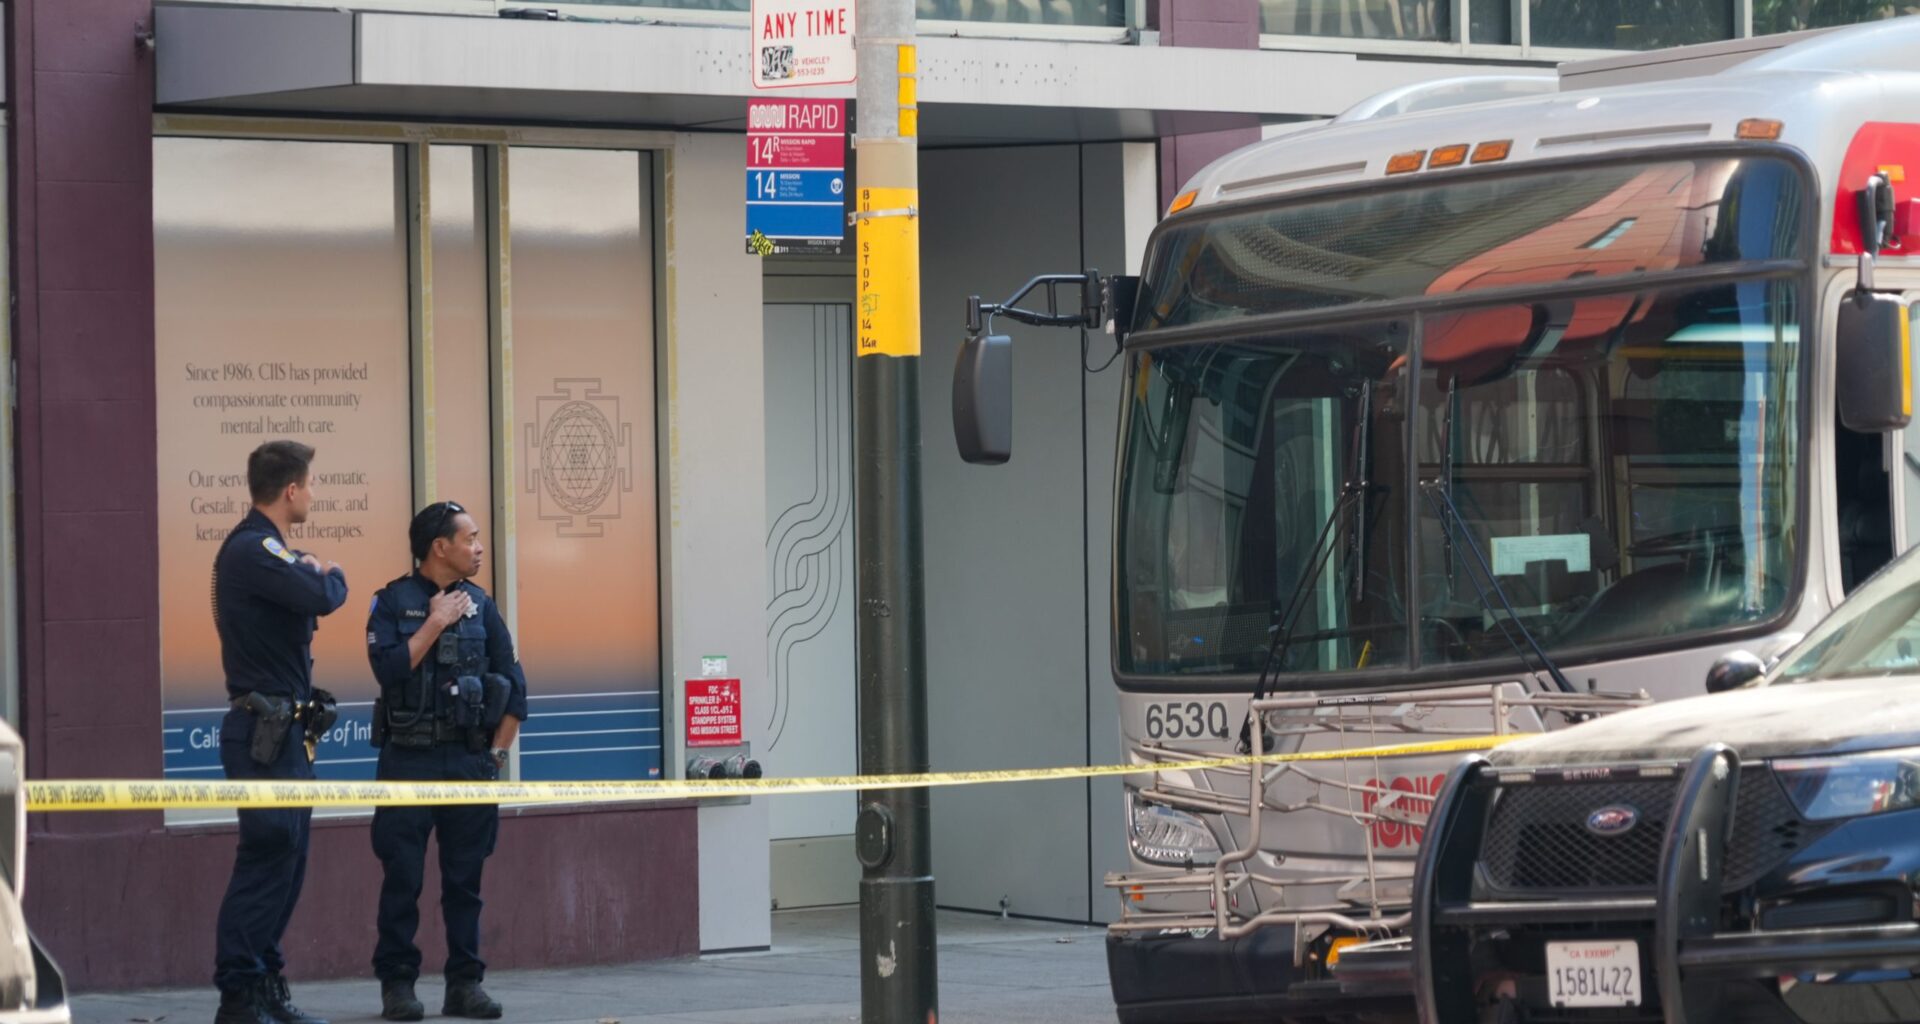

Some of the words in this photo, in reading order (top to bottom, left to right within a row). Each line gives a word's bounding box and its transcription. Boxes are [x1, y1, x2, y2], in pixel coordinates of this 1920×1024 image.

[763, 12, 797, 40] ANY
[806, 8, 847, 36] TIME
[802, 56, 830, 65] VEHICLE?
[788, 104, 839, 129] RAPID
[780, 138, 801, 146] MISSION
[801, 138, 816, 146] RAPID
[755, 171, 777, 199] 14
[862, 319, 872, 330] 14
[185, 362, 219, 381] Since
[258, 362, 286, 381] CIIS
[289, 362, 310, 380] has
[313, 362, 368, 385] provided
[193, 394, 287, 412] compassionate
[290, 392, 362, 411] community
[220, 416, 263, 434] mental
[267, 415, 305, 433] health
[308, 421, 336, 434] care.
[189, 470, 215, 488] Our
[345, 493, 368, 512] and
[307, 520, 364, 543] therapies.
[708, 685, 719, 694] FDC
[689, 695, 715, 705] SPRINKLER
[694, 705, 709, 715] CLASS
[691, 715, 718, 725] STANDPIPE
[718, 715, 737, 724] SYSTEM
[701, 726, 719, 734] MISSION
[720, 725, 738, 734] STREET
[1146, 702, 1227, 739] 6530
[333, 719, 352, 747] of
[46, 785, 67, 804] LINE
[70, 784, 106, 804] SHERIFF
[1569, 950, 1580, 959] CA
[1584, 947, 1616, 958] EXEMPT
[1556, 966, 1633, 996] 1581422
